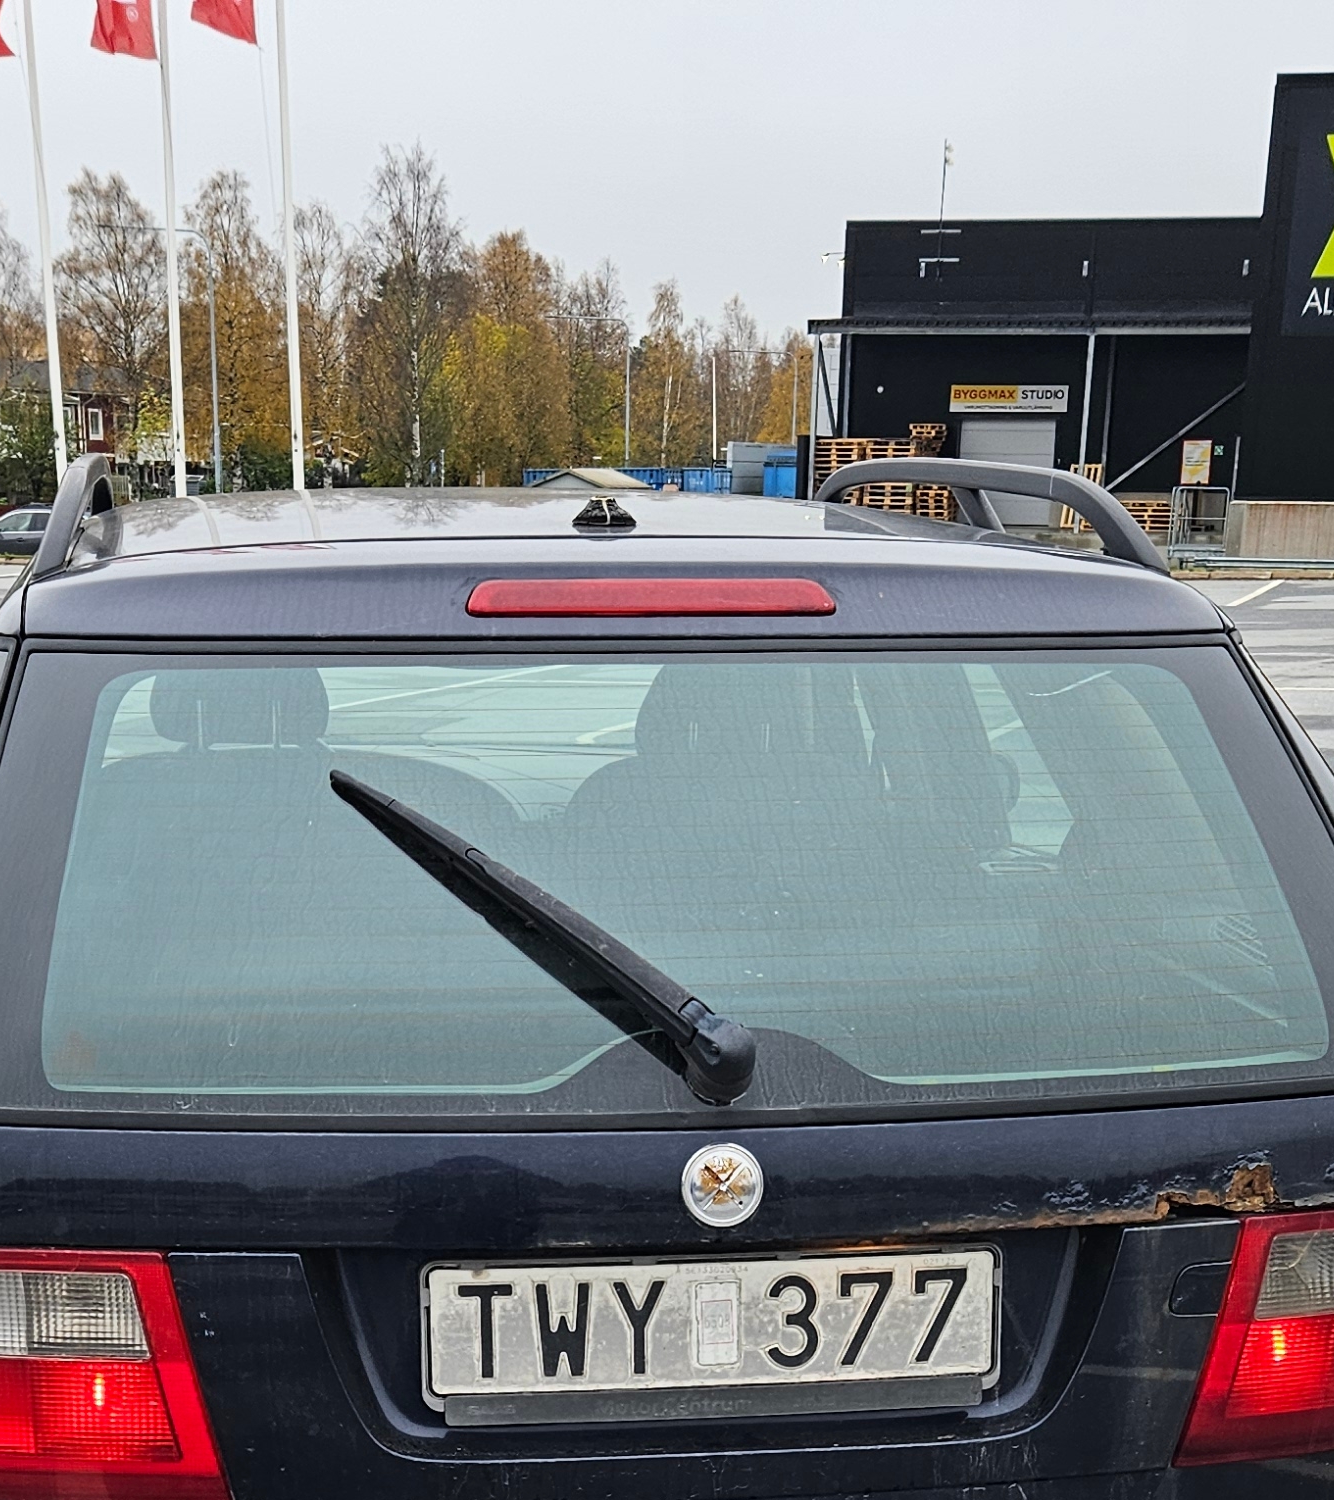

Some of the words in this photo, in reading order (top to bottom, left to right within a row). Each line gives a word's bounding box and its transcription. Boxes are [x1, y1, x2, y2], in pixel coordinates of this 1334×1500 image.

[953, 390, 1016, 400] BYGGMAX
[1021, 389, 1065, 400] STUDIO
[458, 1280, 665, 1377] TWY
[767, 1269, 967, 1367] 377
